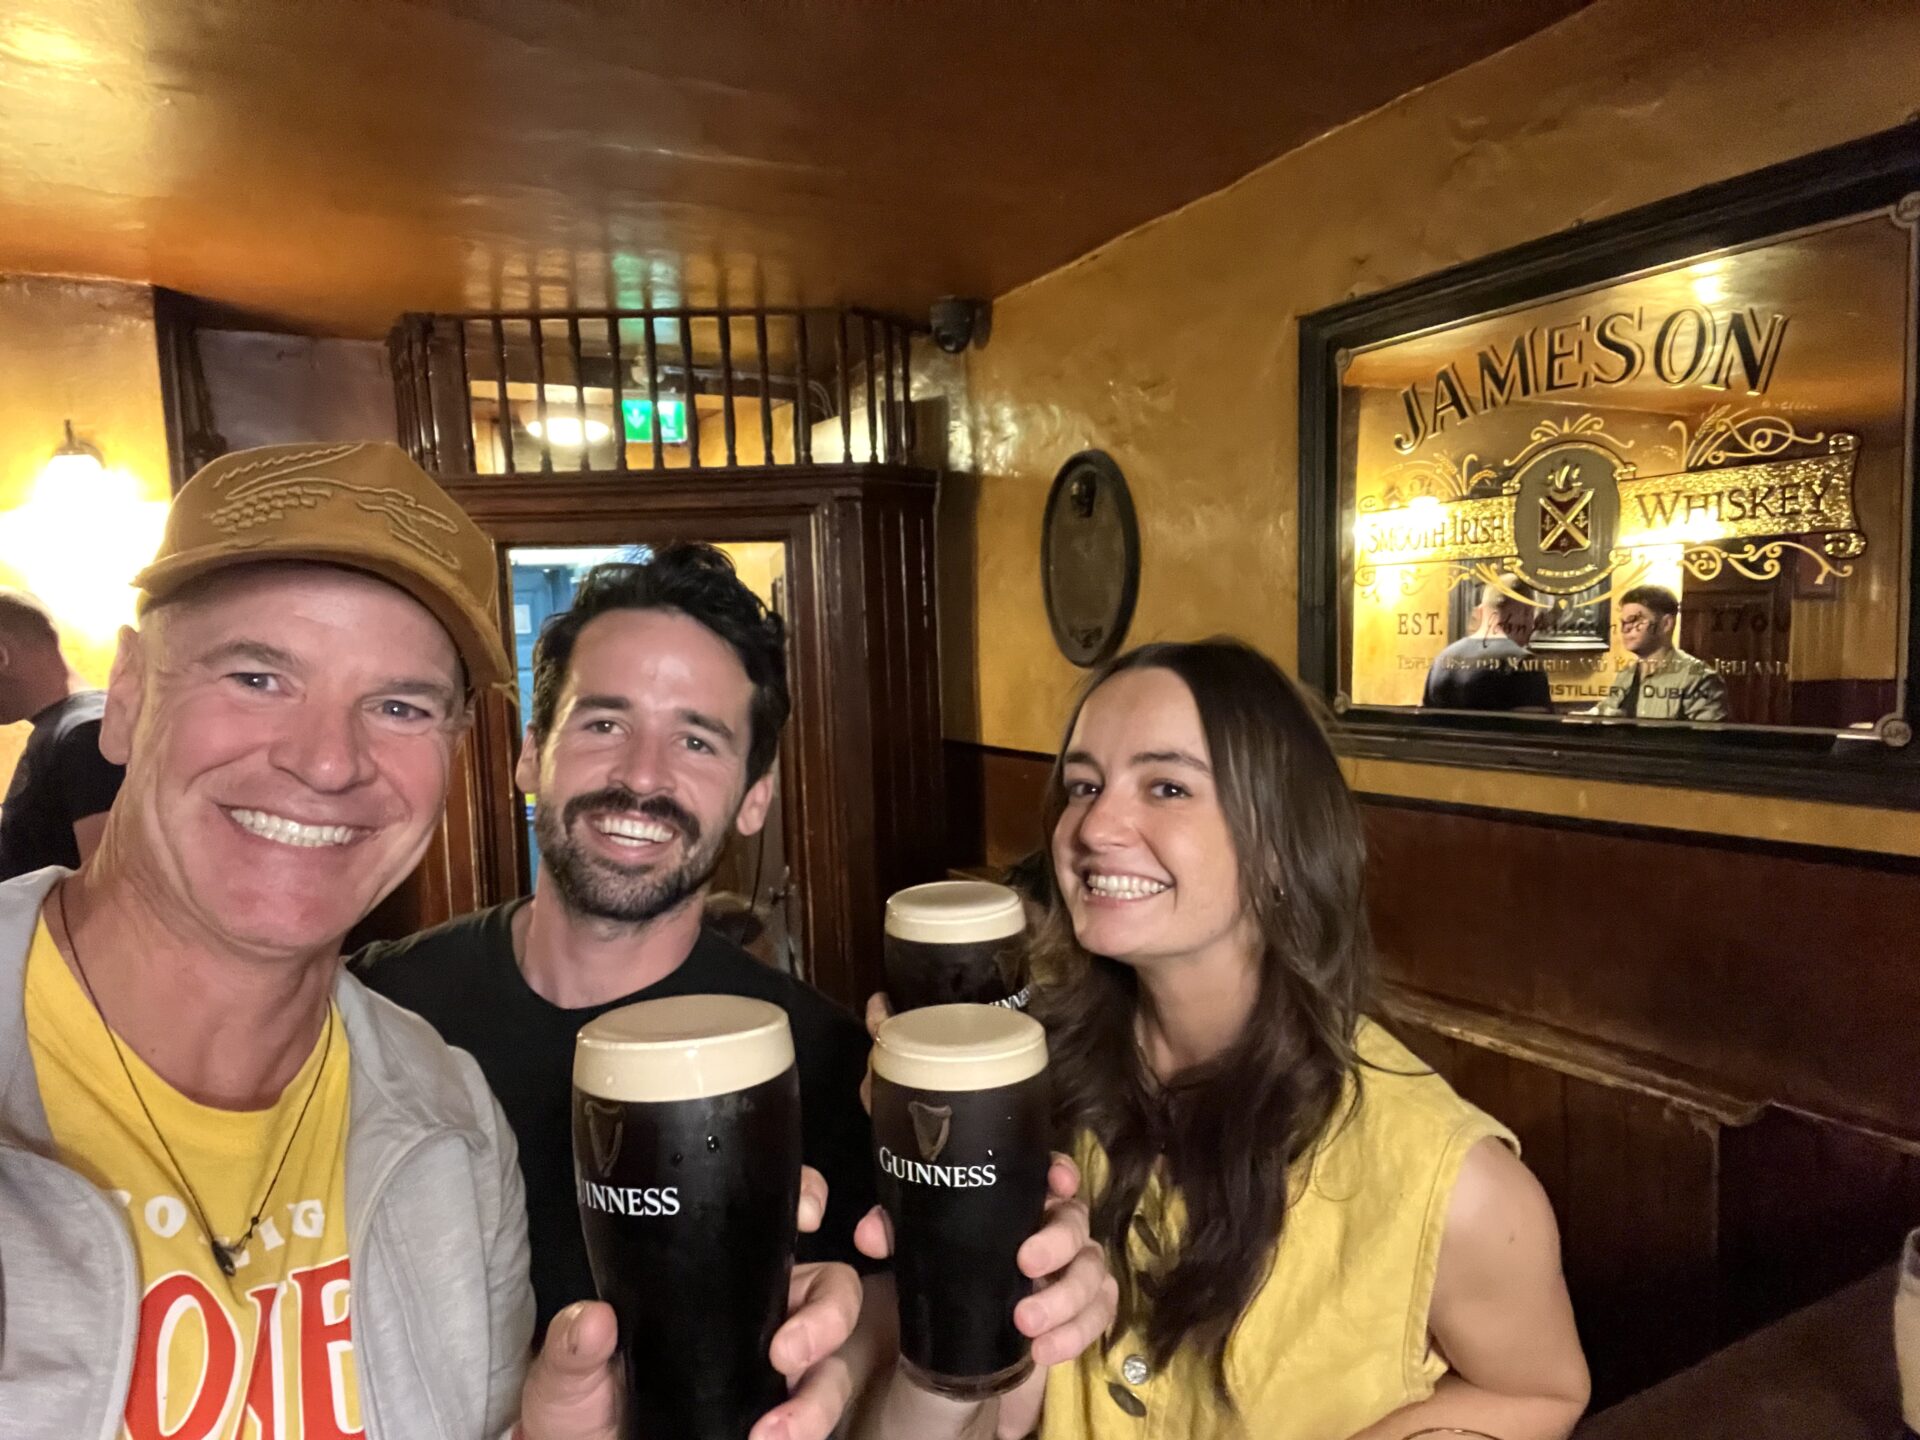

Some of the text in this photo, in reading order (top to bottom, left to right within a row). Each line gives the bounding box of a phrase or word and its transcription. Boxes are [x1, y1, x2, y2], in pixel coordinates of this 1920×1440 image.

[1394, 305, 1790, 454] JAMESON
[1449, 514, 1507, 546] IRISH
[1634, 473, 1836, 529] WHISKEY
[1396, 611, 1444, 636] EST.
[1550, 683, 1628, 699] ISTILLERY
[879, 1146, 997, 1188] GUINNESS
